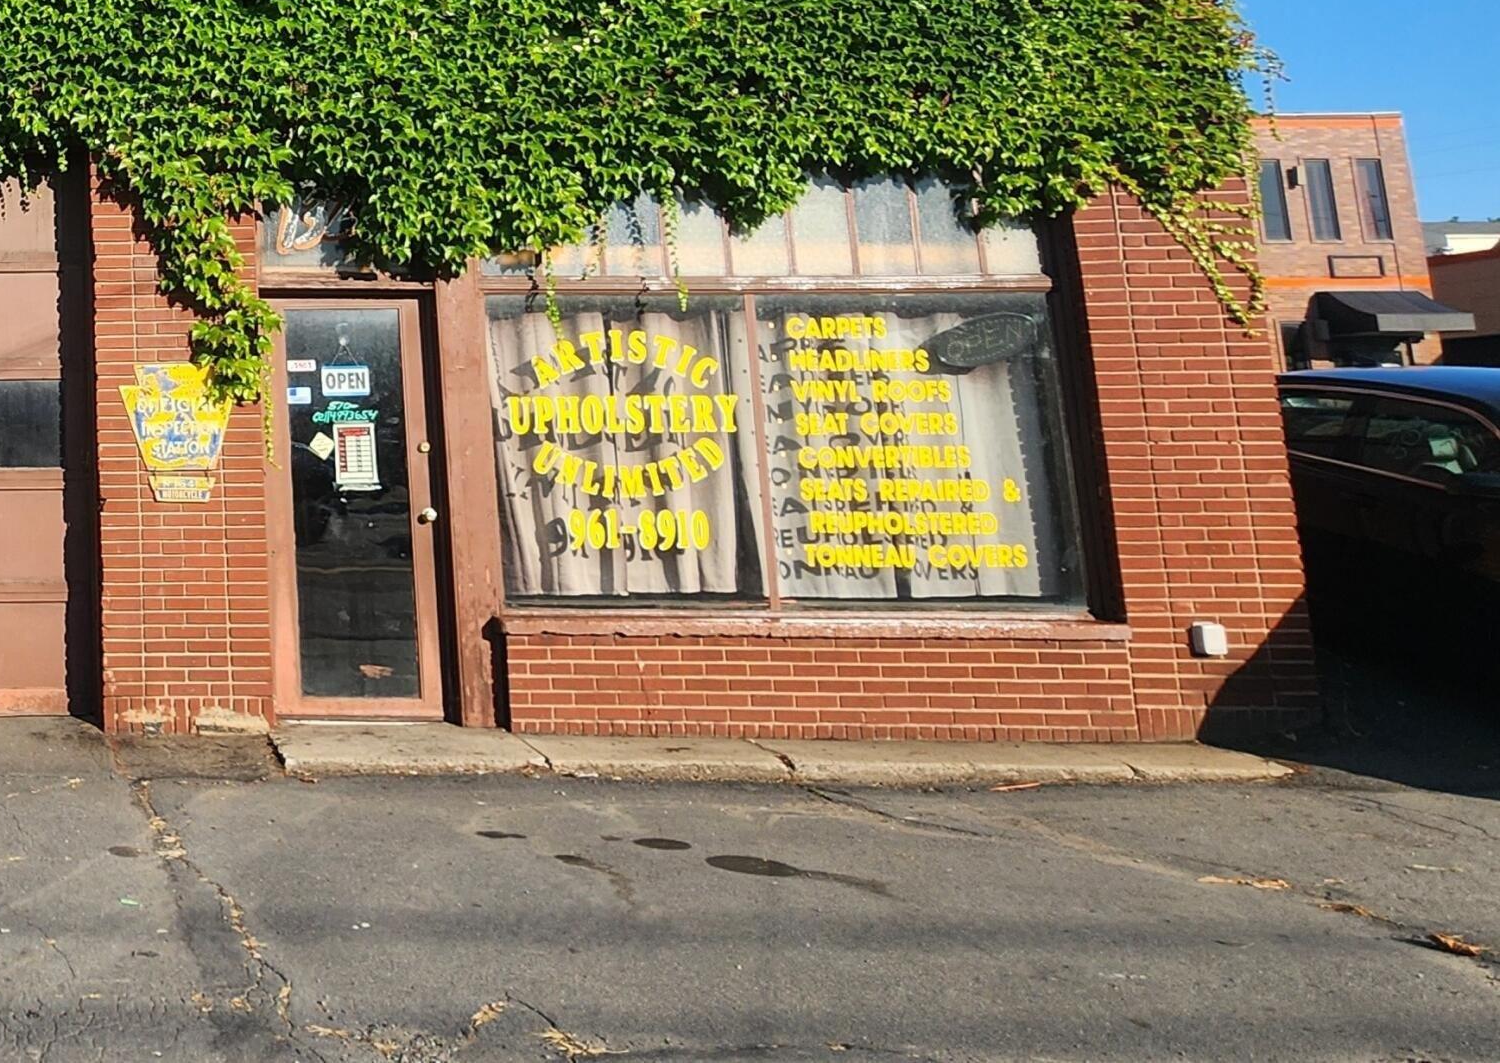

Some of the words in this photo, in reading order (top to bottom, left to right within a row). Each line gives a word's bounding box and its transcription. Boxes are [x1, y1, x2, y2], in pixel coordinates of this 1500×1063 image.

[785, 316, 888, 340] CARPETS
[531, 330, 719, 388] ARTISTIC
[788, 348, 931, 373] HEADLINERS
[325, 371, 367, 390] OPEN
[790, 379, 862, 403] VINYL
[871, 379, 952, 403] ROOFS
[506, 394, 739, 436] UPHOLSTERY
[795, 412, 849, 437] SEAT
[859, 412, 959, 436] COVERS
[151, 441, 211, 458] STATION
[797, 445, 972, 470] CONVERTIBLES
[532, 436, 726, 498] UNLIMITED
[799, 478, 868, 503] SEATS
[878, 479, 991, 503] REPAIRED
[1002, 478, 1022, 503] &
[568, 508, 711, 551] 961-8910
[808, 511, 999, 536] REUPHOLSTERED
[804, 544, 917, 569] TONNEAU
[926, 544, 1030, 569] COVERS
